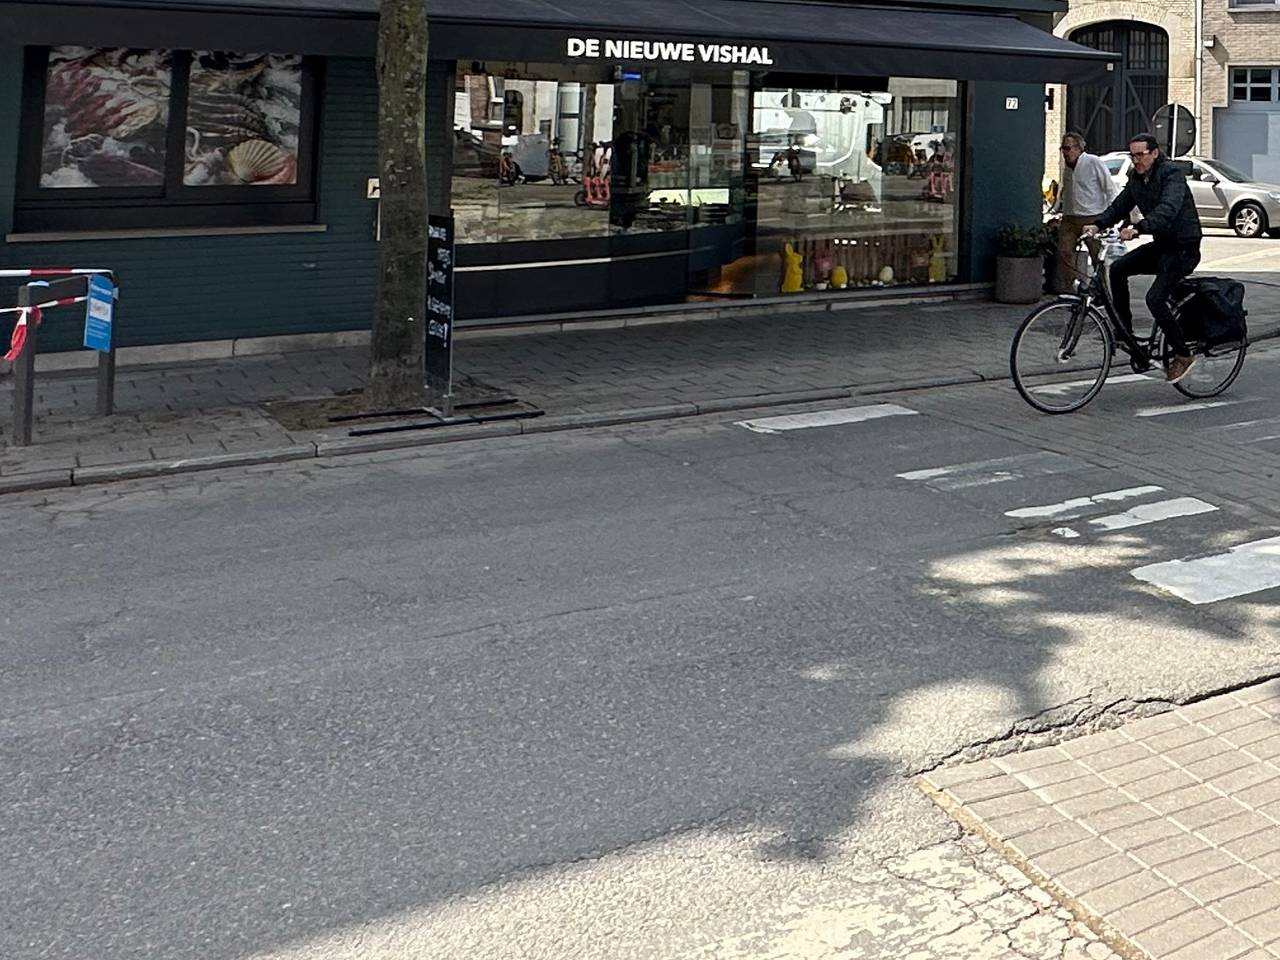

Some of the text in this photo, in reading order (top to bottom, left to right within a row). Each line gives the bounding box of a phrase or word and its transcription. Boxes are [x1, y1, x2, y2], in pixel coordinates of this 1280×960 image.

[567, 38, 773, 65] DE NIEUWE VISHAL
